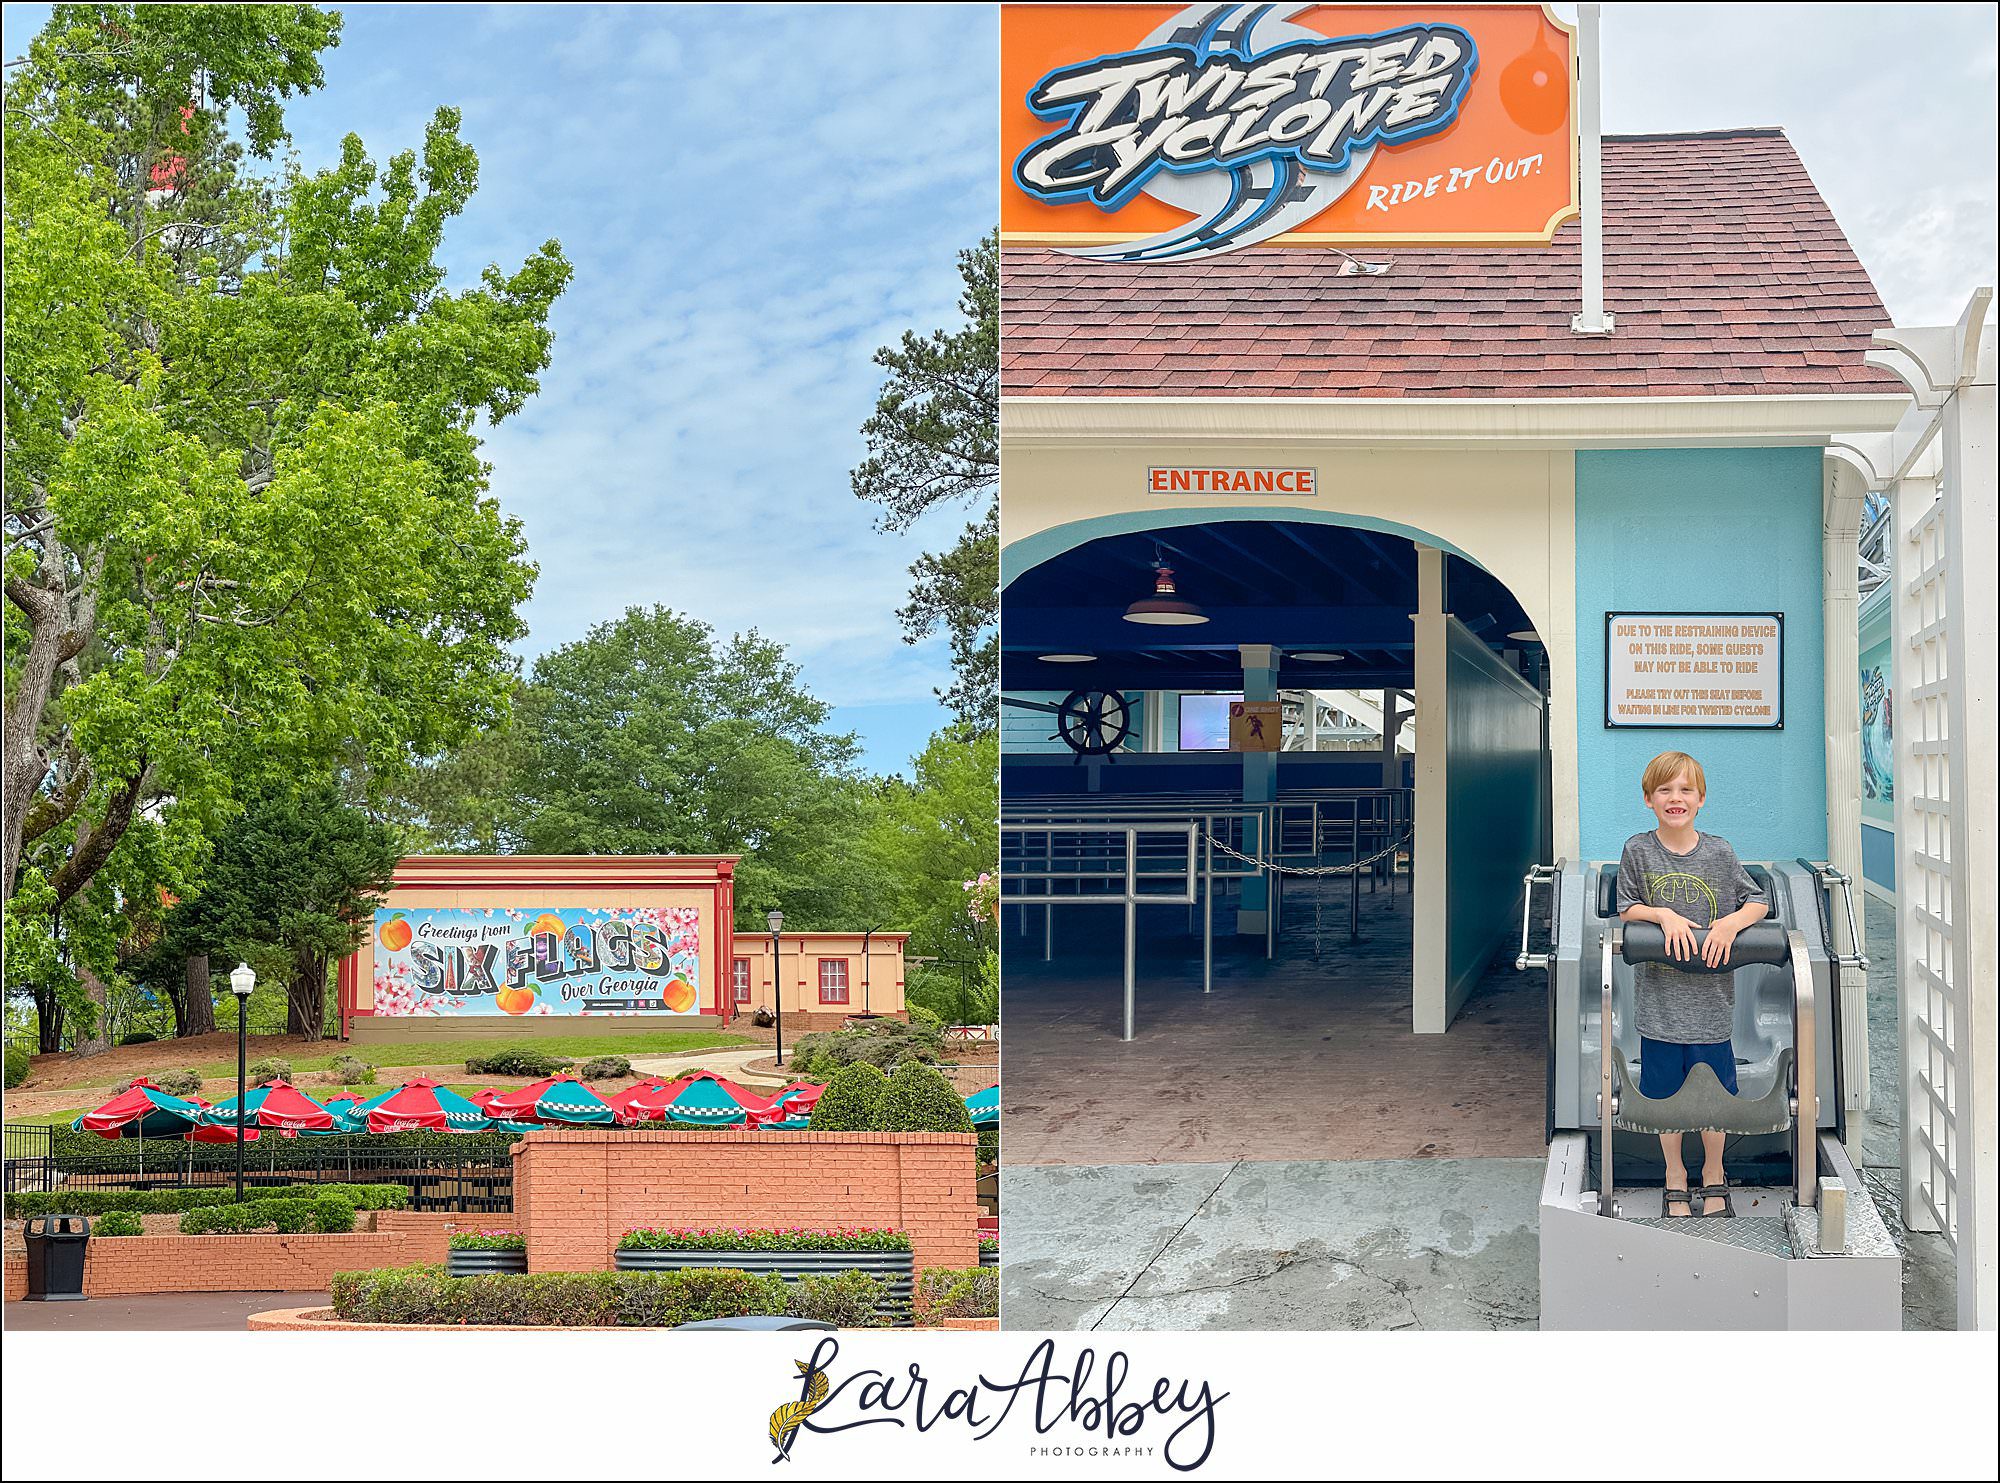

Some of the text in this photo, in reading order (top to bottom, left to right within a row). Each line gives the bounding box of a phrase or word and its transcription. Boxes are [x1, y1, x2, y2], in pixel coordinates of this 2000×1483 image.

[1037, 36, 1461, 135] TWISTED
[1023, 74, 1454, 194] CYCLONE
[1366, 153, 1543, 212] RIDE IT OUT!
[1152, 470, 1312, 492] ENTRANCE
[1617, 625, 1776, 637] DUE TO THE RESTRAINING DEVICE
[1629, 643, 1764, 657] ON THIS RIDE, SOME GUESTS
[1634, 661, 1758, 673] MAY NOT BE ABLE TO RIDE
[1626, 689, 1762, 700] PLEASE TRY OUT THIS SEAT BEFORE
[1617, 704, 1771, 716] WAITING IN LINE FOR TWISTED CYCLONE
[418, 922, 510, 942] Greetings from
[411, 921, 671, 995] SIX FLAGS
[561, 976, 658, 1000] Over Georgia
